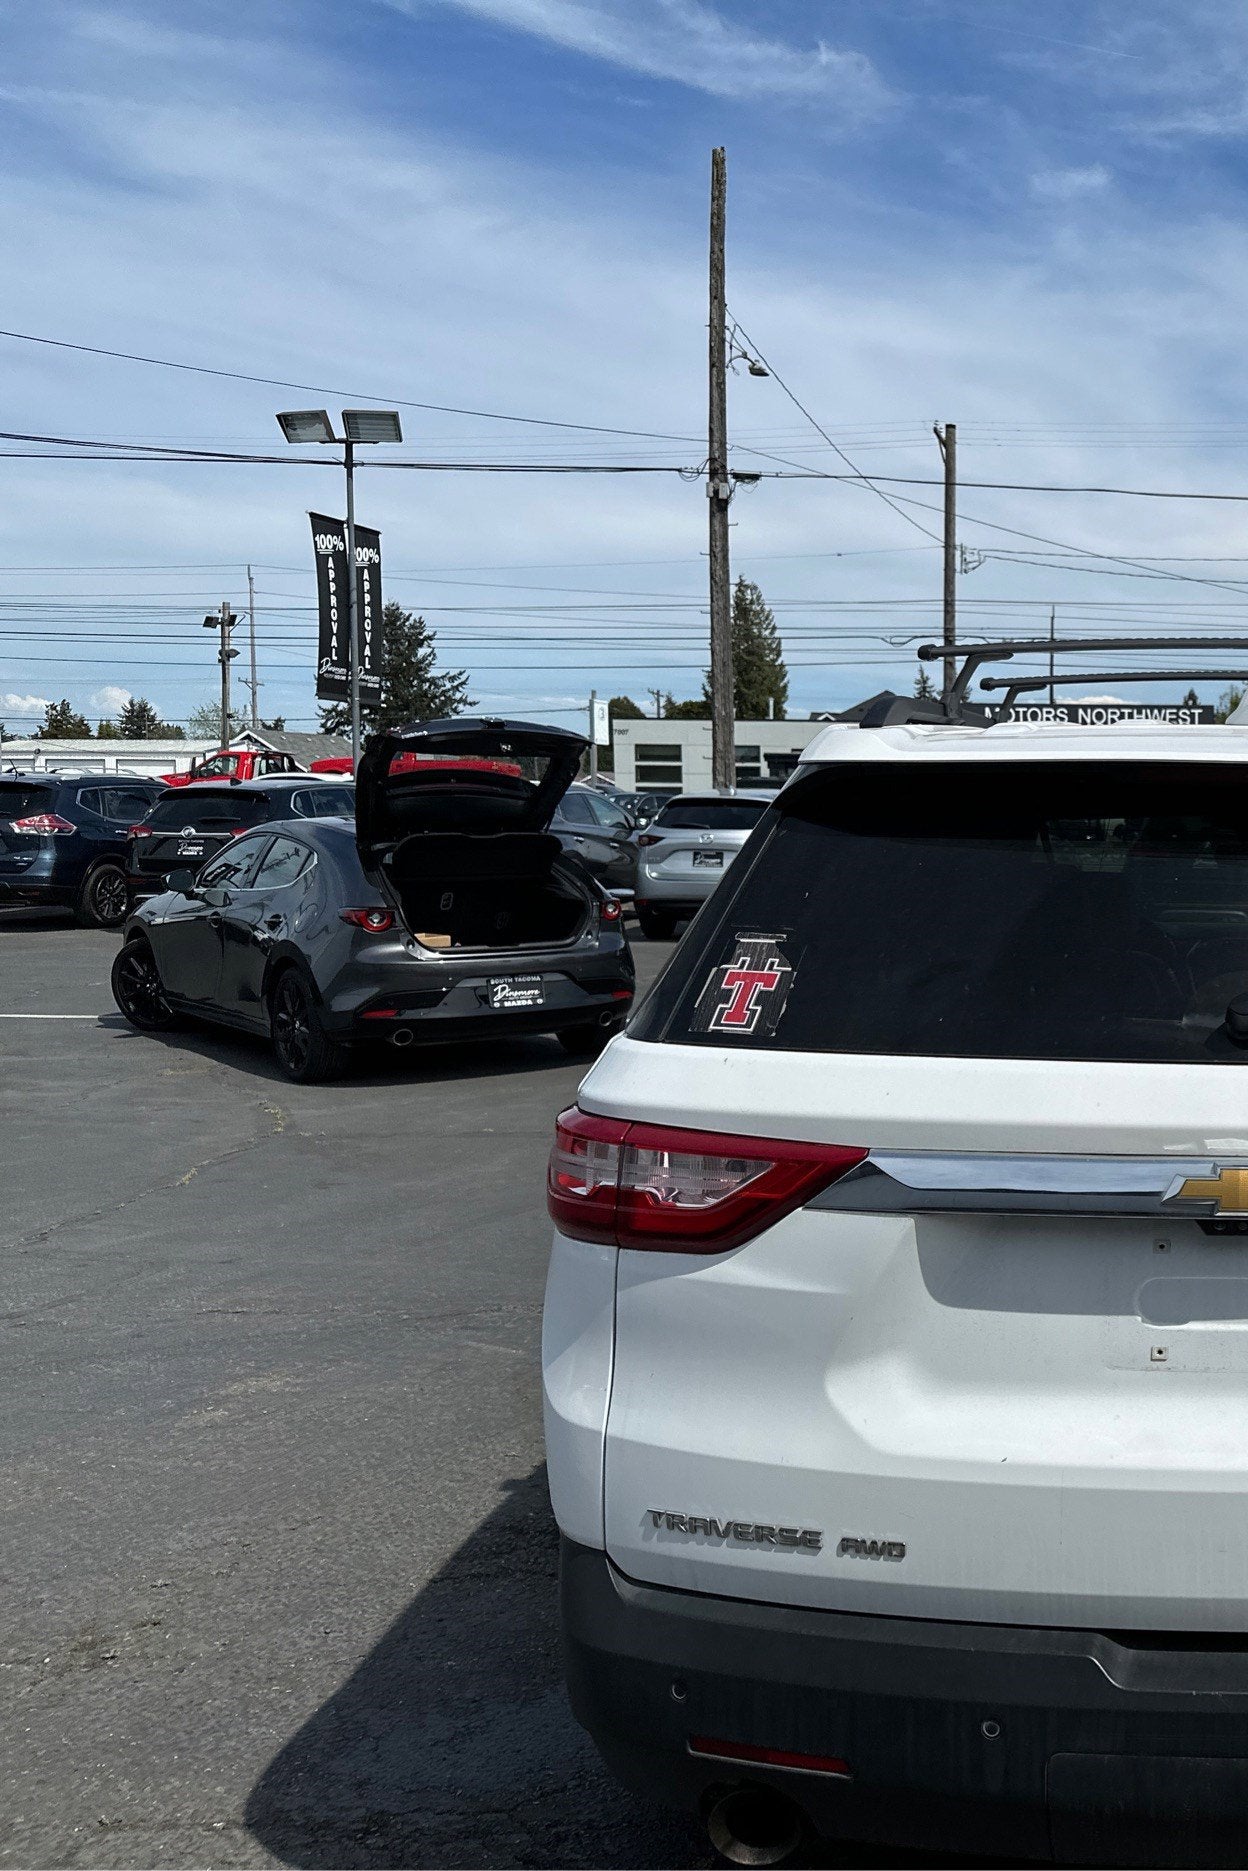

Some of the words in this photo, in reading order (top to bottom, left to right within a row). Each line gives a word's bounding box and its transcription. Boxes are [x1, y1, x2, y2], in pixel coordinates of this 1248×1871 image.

[315, 534, 345, 552] 100%
[354, 547, 380, 564] 00%
[327, 556, 338, 661] APPROVAL
[363, 568, 372, 669] APPROVAL
[1077, 708, 1204, 725] NORTHWEST
[514, 975, 541, 983] TACOMA
[646, 1509, 824, 1550] TRAVERSE
[840, 1535, 907, 1559] AWD
